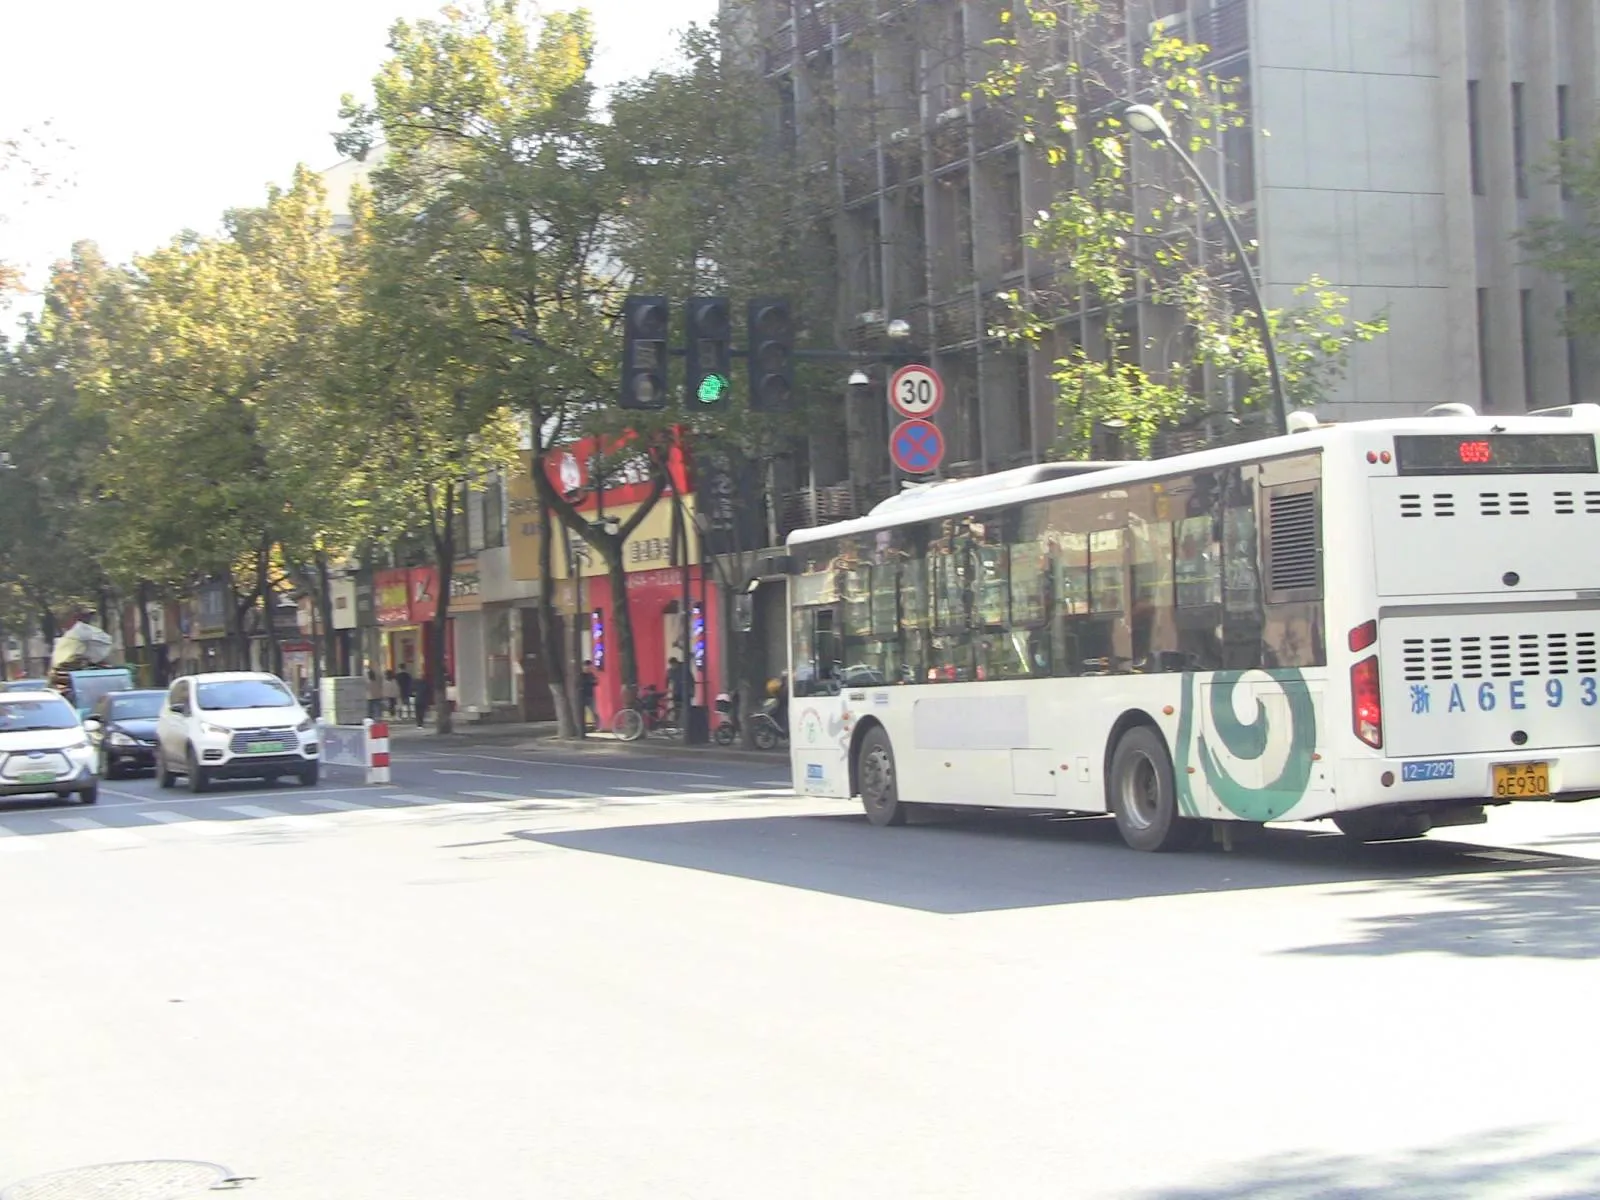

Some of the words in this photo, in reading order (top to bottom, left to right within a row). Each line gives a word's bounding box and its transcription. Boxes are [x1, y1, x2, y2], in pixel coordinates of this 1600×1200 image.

[902, 380, 931, 404] 30
[1403, 762, 1453, 779] 12-7292
[1496, 776, 1546, 796] 6E930
